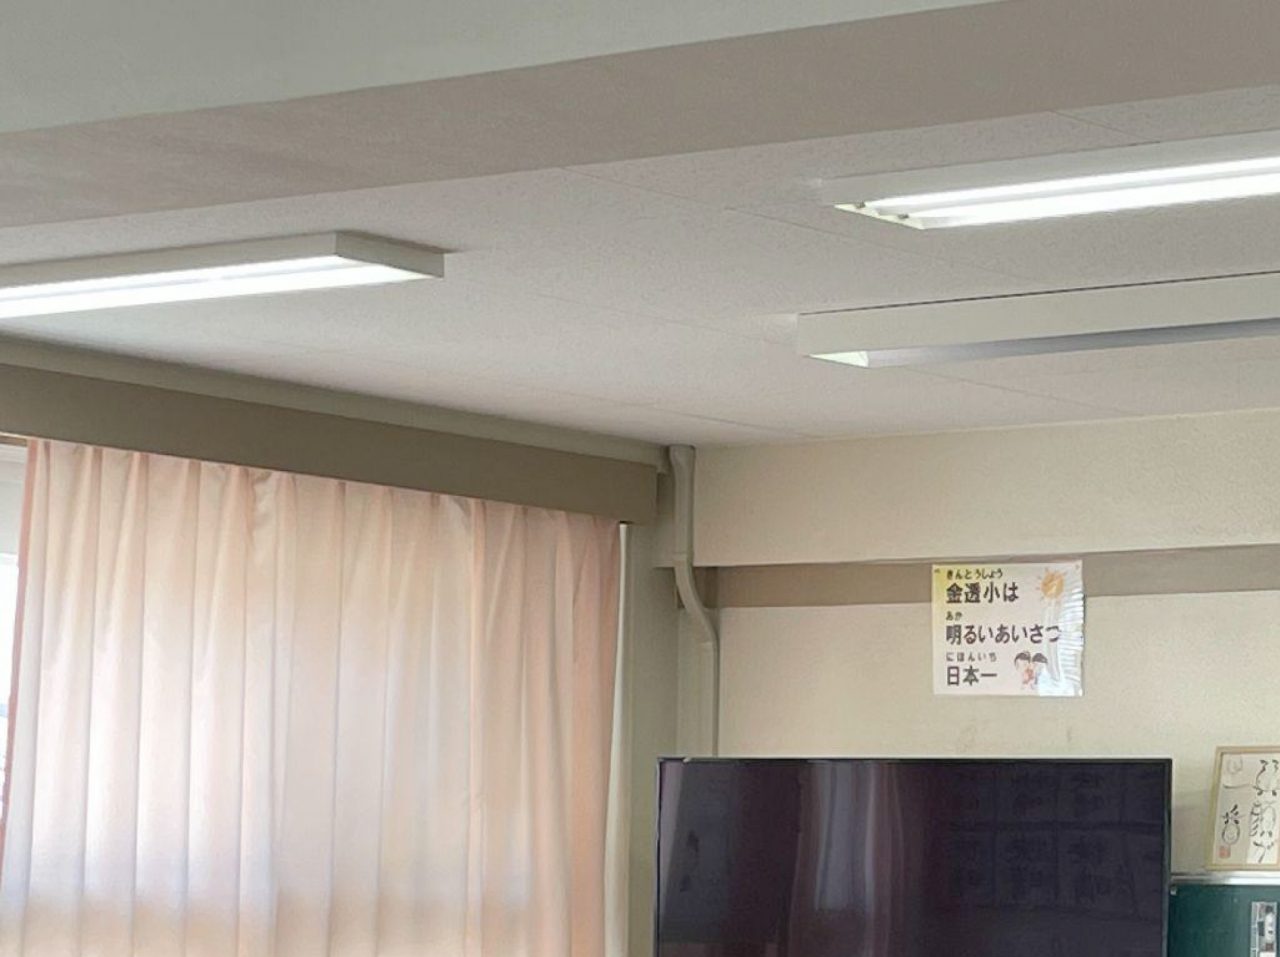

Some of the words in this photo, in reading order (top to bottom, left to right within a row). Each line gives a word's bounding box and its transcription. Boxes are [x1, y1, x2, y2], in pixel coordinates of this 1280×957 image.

[946, 581, 1019, 604] 金透小は
[945, 623, 1061, 646] 明るいあいさつ
[946, 665, 998, 687] 日本一
